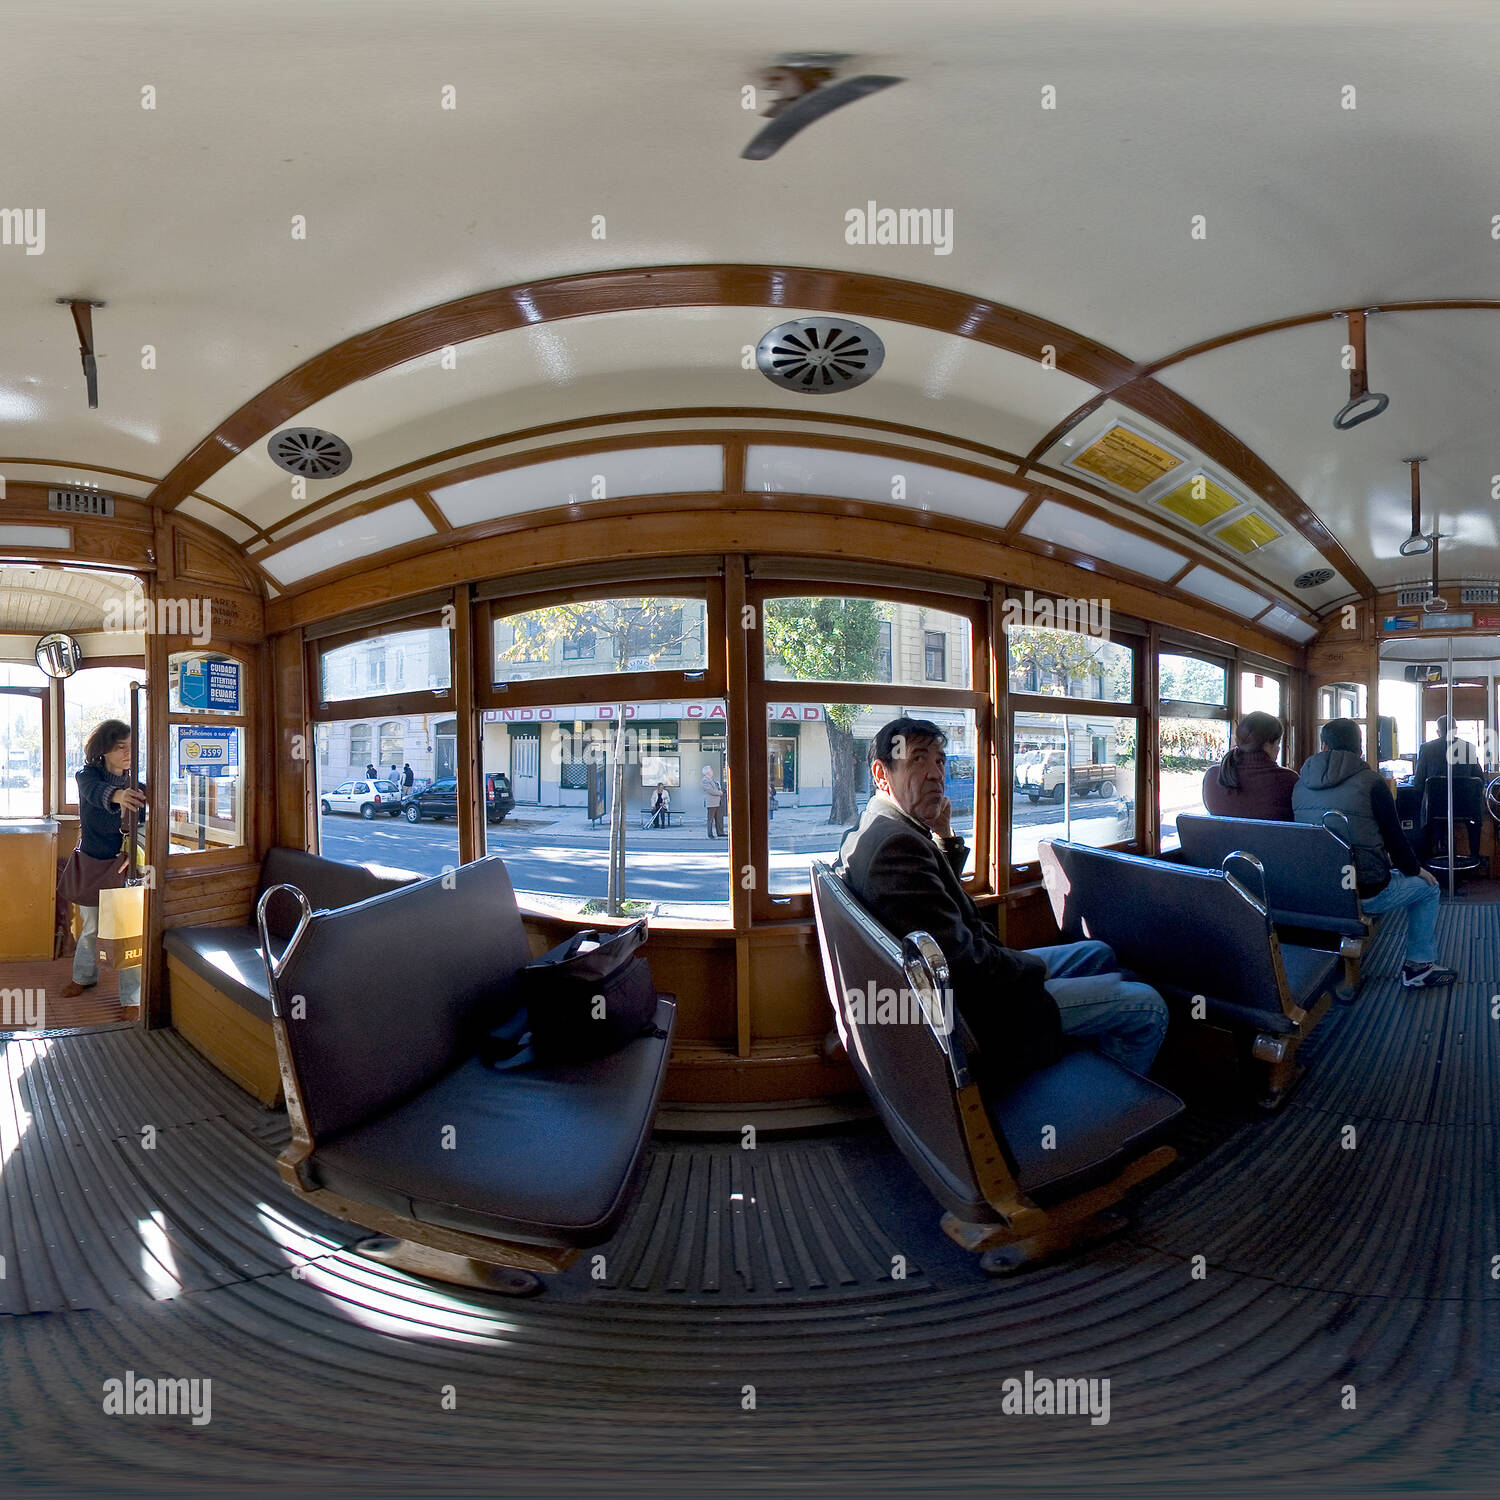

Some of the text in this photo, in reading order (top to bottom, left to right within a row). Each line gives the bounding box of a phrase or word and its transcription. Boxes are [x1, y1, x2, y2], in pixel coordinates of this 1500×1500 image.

[210, 663, 237, 675] CUIDADO
[210, 676, 237, 686] ATTENTION
[210, 688, 237, 699] BEWARE
[599, 706, 635, 719] DO
[202, 748, 222, 757] 3599
